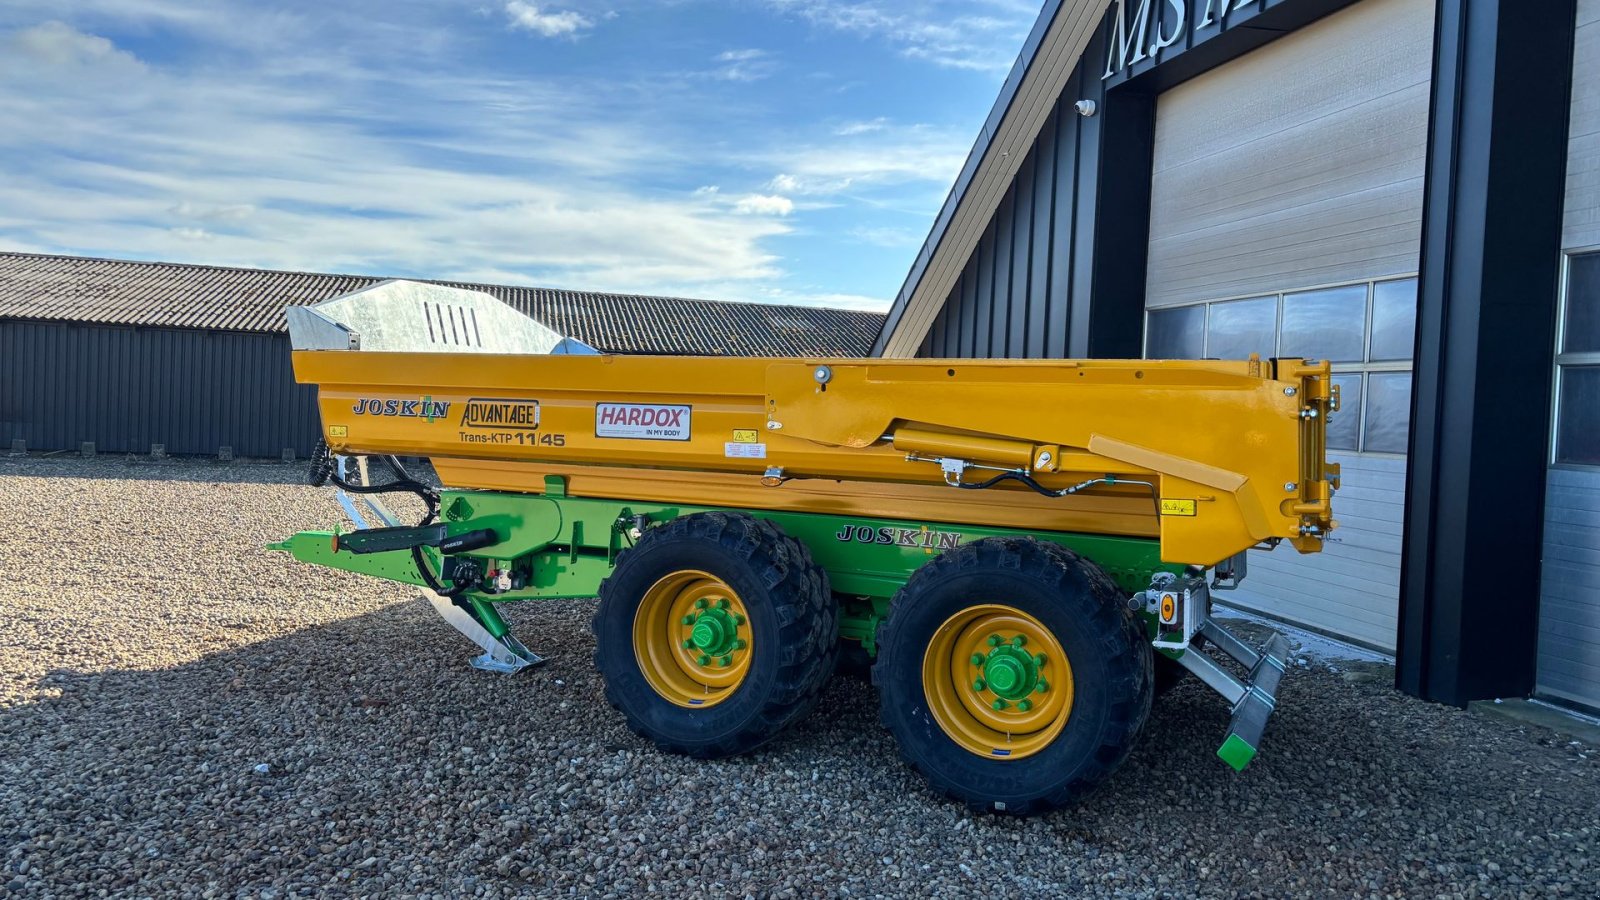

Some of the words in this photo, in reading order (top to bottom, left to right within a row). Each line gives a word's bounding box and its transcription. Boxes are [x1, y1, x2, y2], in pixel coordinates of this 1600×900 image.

[353, 398, 451, 418] JOSKIN
[460, 403, 534, 427] ADVANTAGE
[600, 407, 683, 427] HARDOX
[459, 432, 513, 444] Trans-KTP
[514, 432, 565, 447] 11/45
[836, 525, 961, 549] JOSKIN
